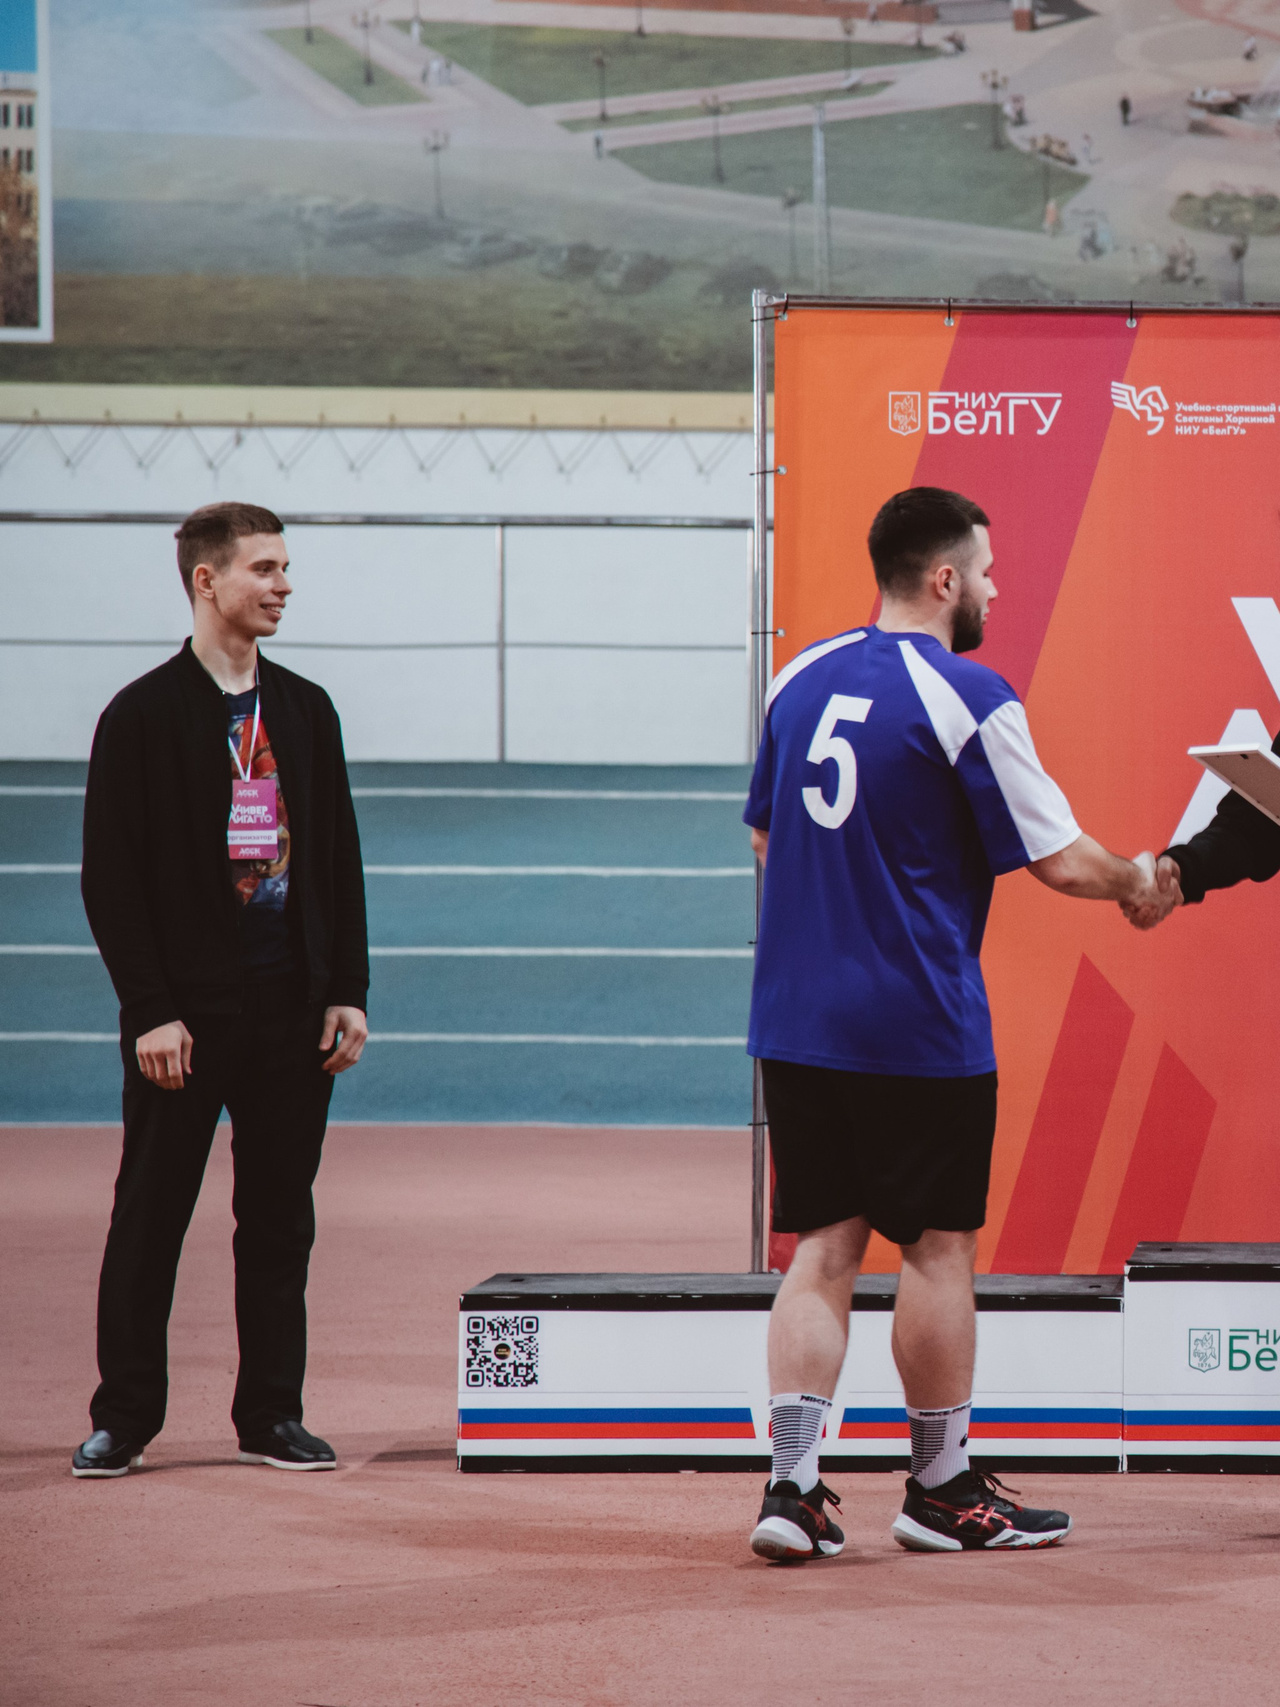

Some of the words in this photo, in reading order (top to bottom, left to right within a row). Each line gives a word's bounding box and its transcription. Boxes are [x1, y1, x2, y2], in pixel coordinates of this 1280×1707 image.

[955, 391, 1002, 409] НИУ
[1175, 402, 1276, 414] Учебно-спортивный
[928, 398, 1062, 436] БелГУ
[1174, 413, 1224, 423] Светланы
[1225, 414, 1276, 424] Хоркиной
[1175, 425, 1200, 435] НИУ
[1202, 425, 1247, 436] «БелГУ»
[801, 693, 874, 830] 5
